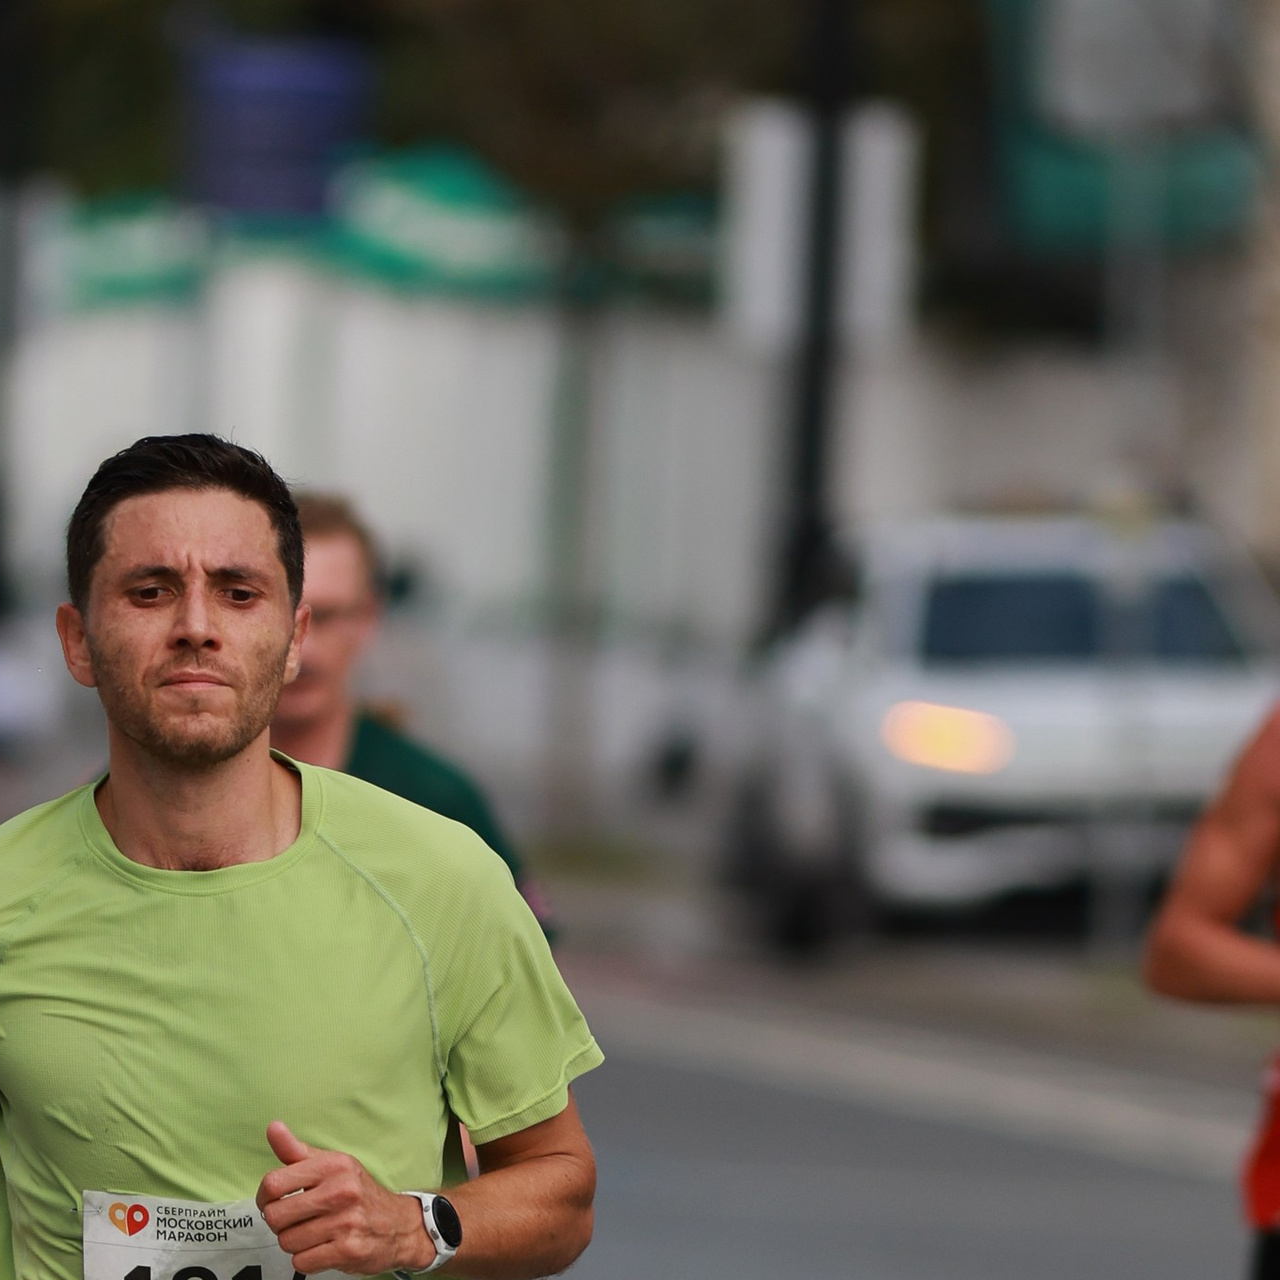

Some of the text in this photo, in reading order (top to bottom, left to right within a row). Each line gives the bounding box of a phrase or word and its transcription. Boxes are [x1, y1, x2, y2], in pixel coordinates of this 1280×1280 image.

[156, 1205, 226, 1218] СБЕРПРАЙМ
[156, 1215, 253, 1231] МОСКОВСКИЙ
[156, 1230, 227, 1242] МАРАФОН
